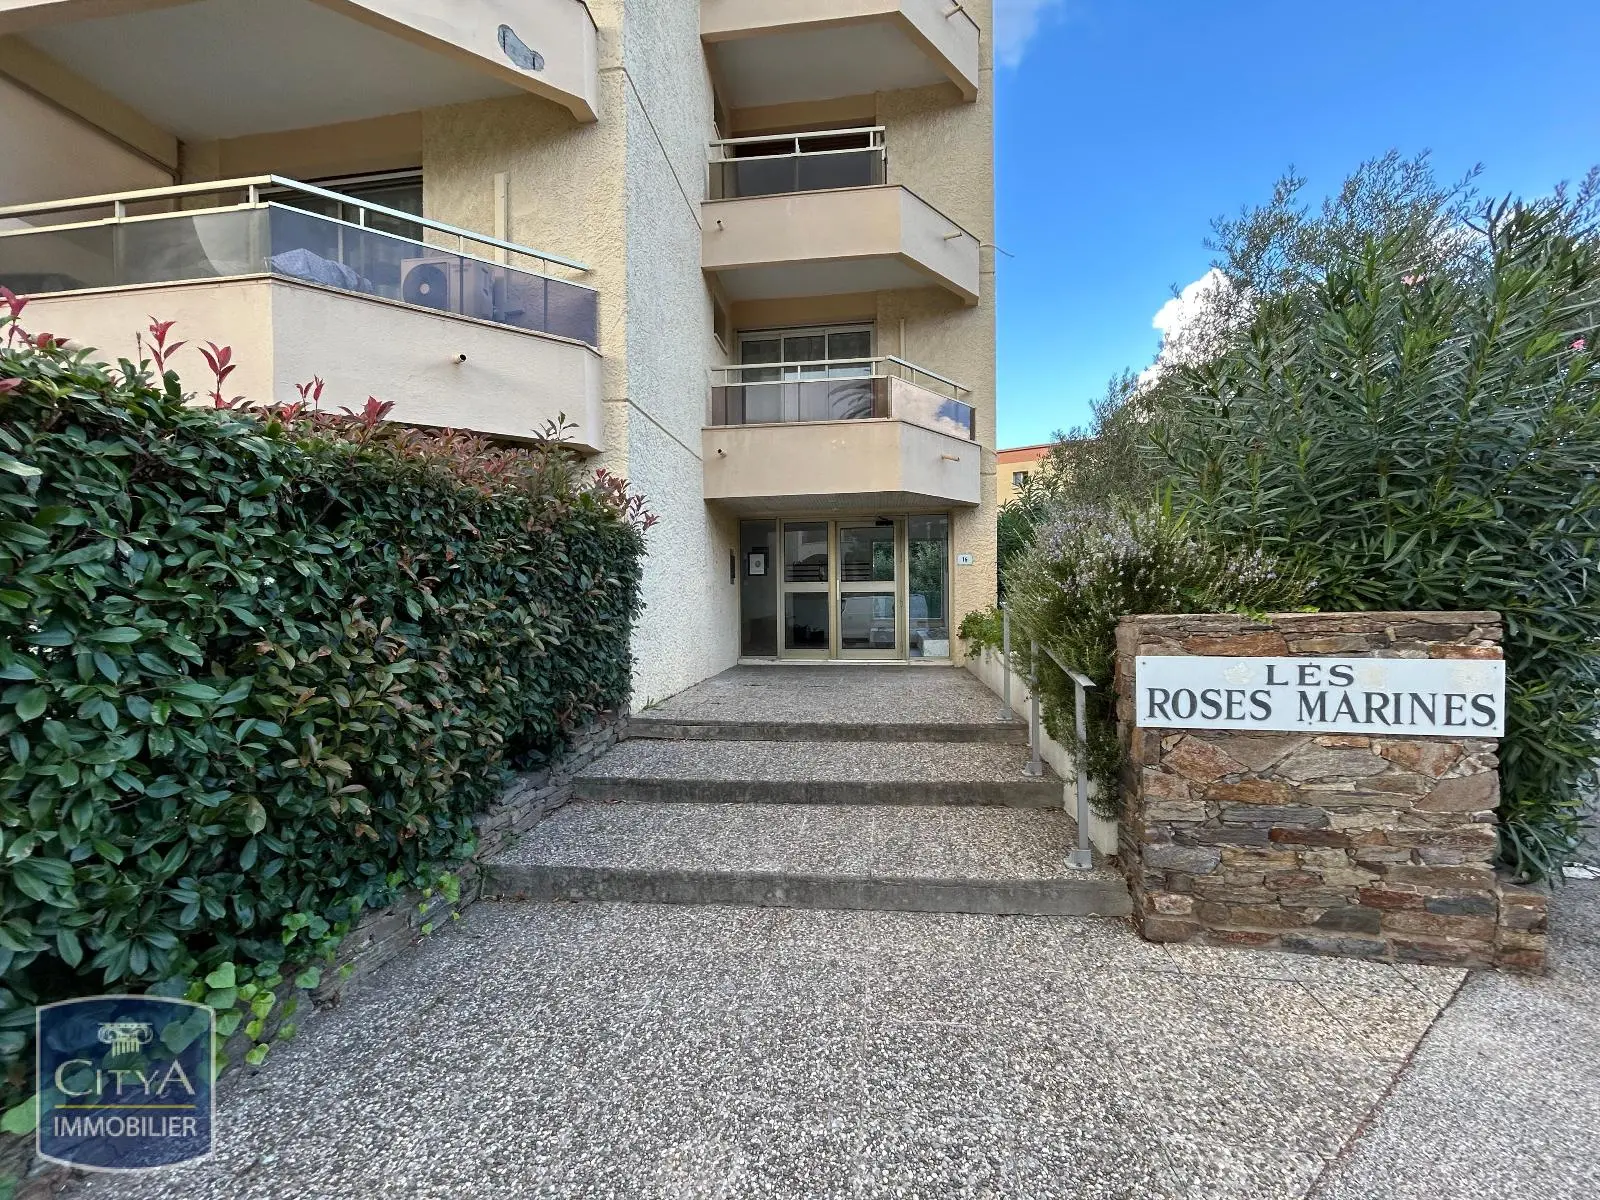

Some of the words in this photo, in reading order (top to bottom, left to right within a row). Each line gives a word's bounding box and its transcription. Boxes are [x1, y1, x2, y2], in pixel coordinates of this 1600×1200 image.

[1265, 664, 1355, 687] LES
[1147, 687, 1272, 722] ROSES
[1297, 690, 1497, 728] MARINES
